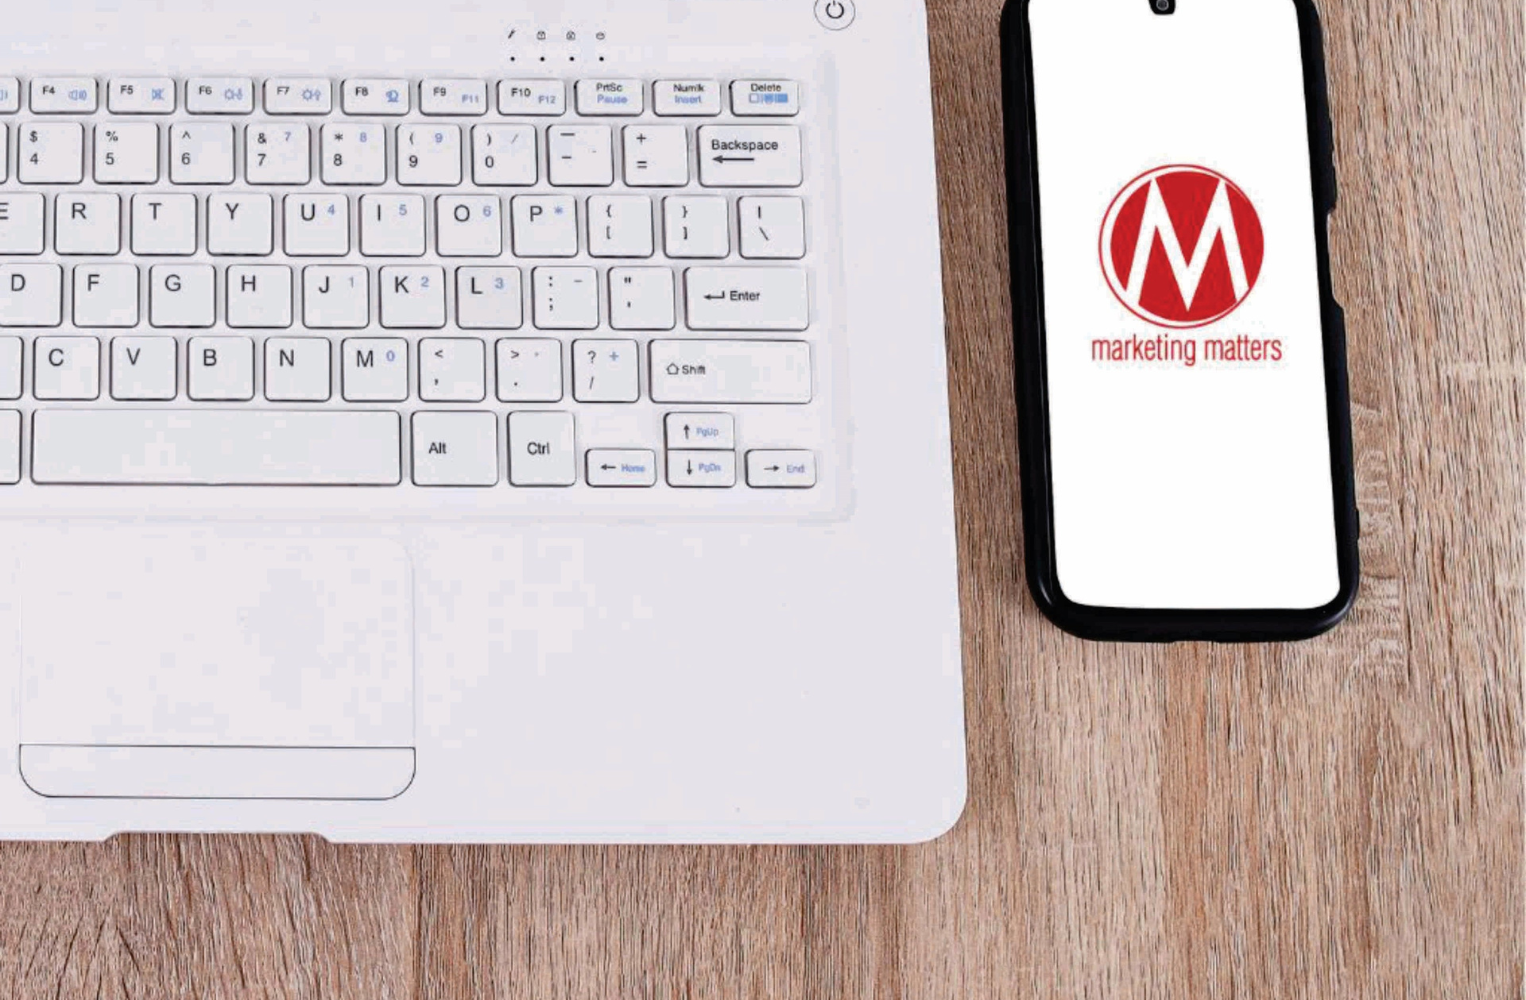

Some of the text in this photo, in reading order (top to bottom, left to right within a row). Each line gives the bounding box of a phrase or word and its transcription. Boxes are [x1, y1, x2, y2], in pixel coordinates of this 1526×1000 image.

[42, 85, 56, 95] F4
[120, 84, 134, 95] F5
[198, 85, 213, 96] F6
[276, 85, 291, 96] F7
[355, 86, 369, 97] F8
[432, 86, 447, 97] F9
[510, 87, 532, 98] F10
[595, 82, 623, 93] PrtSc
[750, 83, 782, 93] Delete
[284, 131, 292, 142] 7
[359, 131, 368, 143] 8
[434, 132, 444, 144] 9
[711, 138, 779, 153] Backspace
[29, 152, 39, 165] 4
[105, 152, 115, 166] 5
[181, 151, 191, 166] 6
[257, 152, 267, 167] 7
[333, 153, 343, 167] 8
[408, 154, 419, 168] 9
[484, 155, 495, 169] 0
[71, 202, 87, 220] R
[148, 202, 163, 221] T
[225, 202, 240, 220] Y
[300, 203, 316, 222] U
[327, 203, 336, 216] 4
[398, 203, 408, 217] 5
[453, 203, 471, 223] O
[482, 205, 492, 218] 6
[529, 205, 543, 222] P
[10, 273, 26, 292] D
[87, 273, 101, 292] F
[164, 273, 182, 292] G
[241, 274, 256, 292] H
[318, 275, 330, 294] J
[394, 275, 409, 294] K
[420, 275, 430, 288] 2
[470, 276, 483, 295] L
[494, 277, 505, 290] 3
[729, 290, 761, 302] Enter
[126, 347, 141, 366] V
[385, 349, 396, 362] 0
[1091, 333, 1283, 367] marketing matters
[48, 348, 64, 367] C
[203, 348, 217, 367] B
[279, 348, 295, 367] N
[356, 349, 374, 368] M
[681, 364, 706, 375] Shift
[428, 441, 447, 455] Alt
[526, 441, 550, 456] Ctrl
